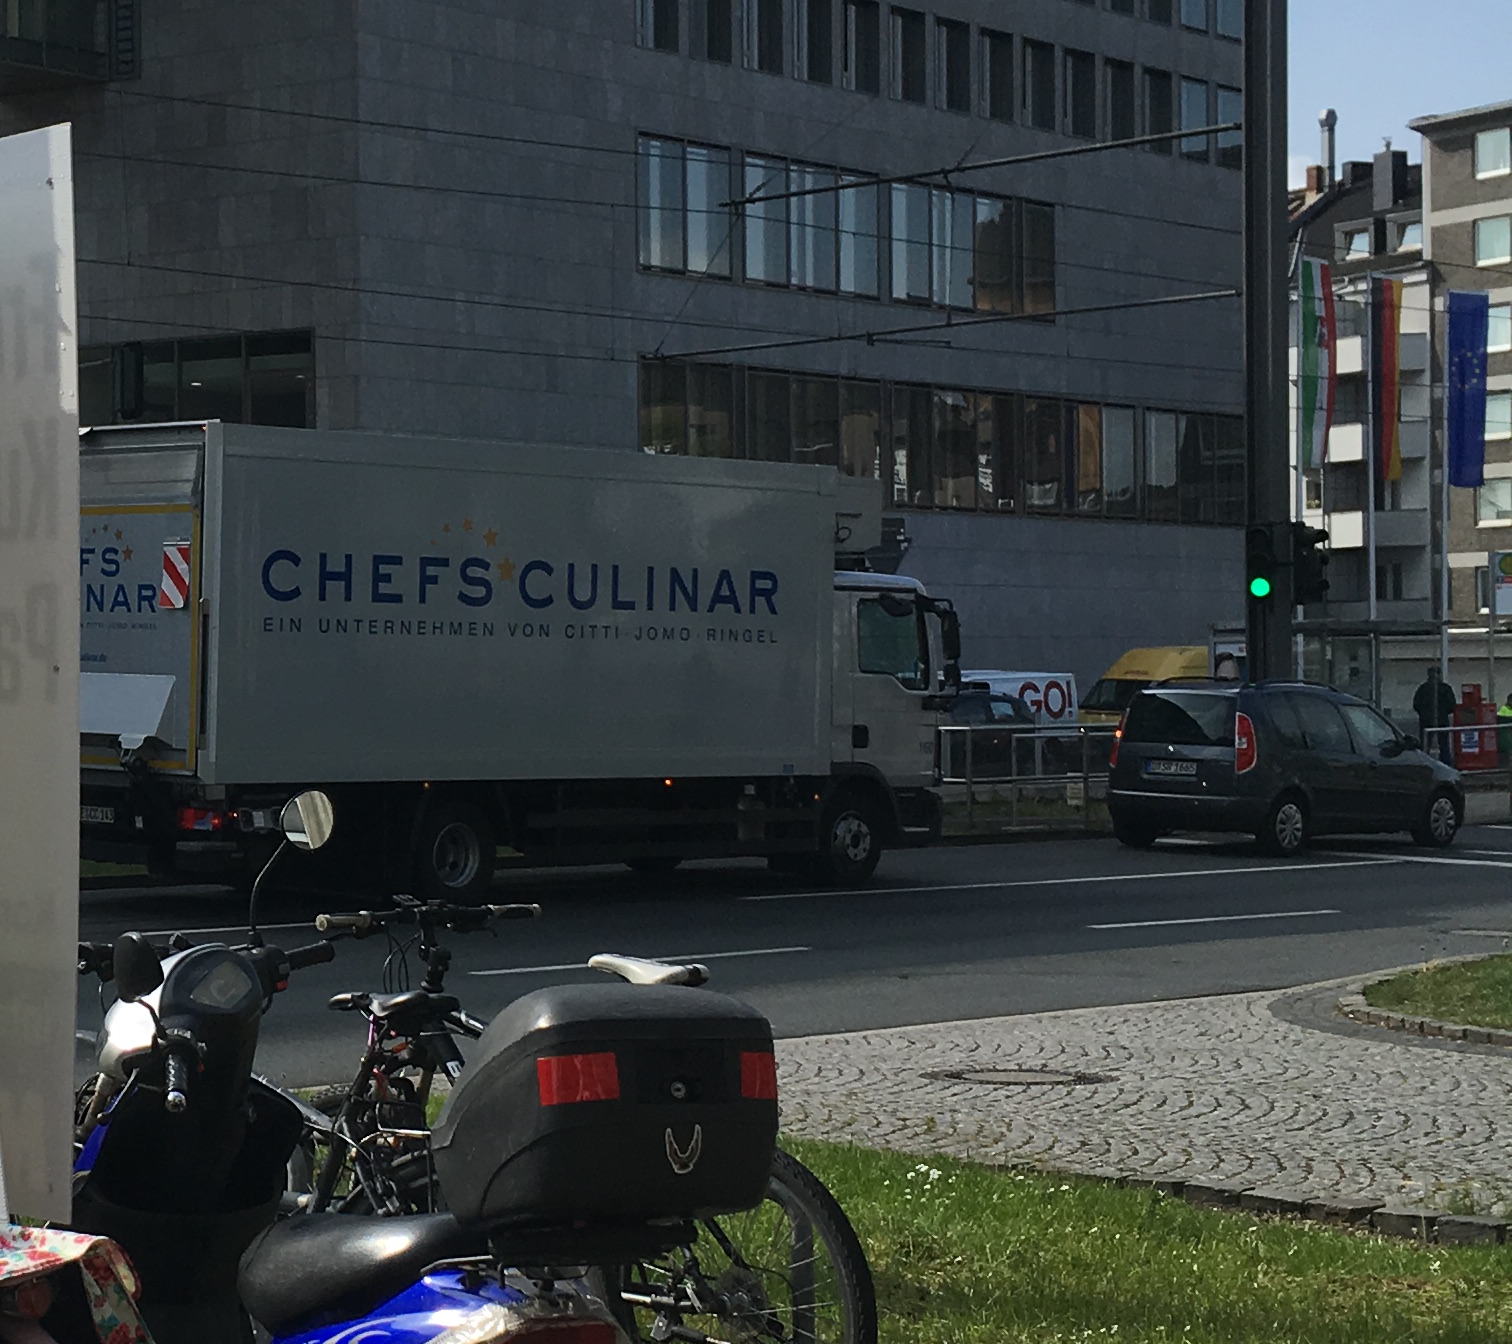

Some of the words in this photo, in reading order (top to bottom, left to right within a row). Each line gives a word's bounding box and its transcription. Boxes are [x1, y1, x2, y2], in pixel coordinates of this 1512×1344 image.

[261, 549, 494, 607] CHEFS
[518, 560, 779, 616] CULINAR
[263, 617, 302, 633] EIN
[318, 618, 494, 637] UNTERNEHMEN
[507, 622, 550, 639] VON
[1018, 679, 1073, 720] GO!
